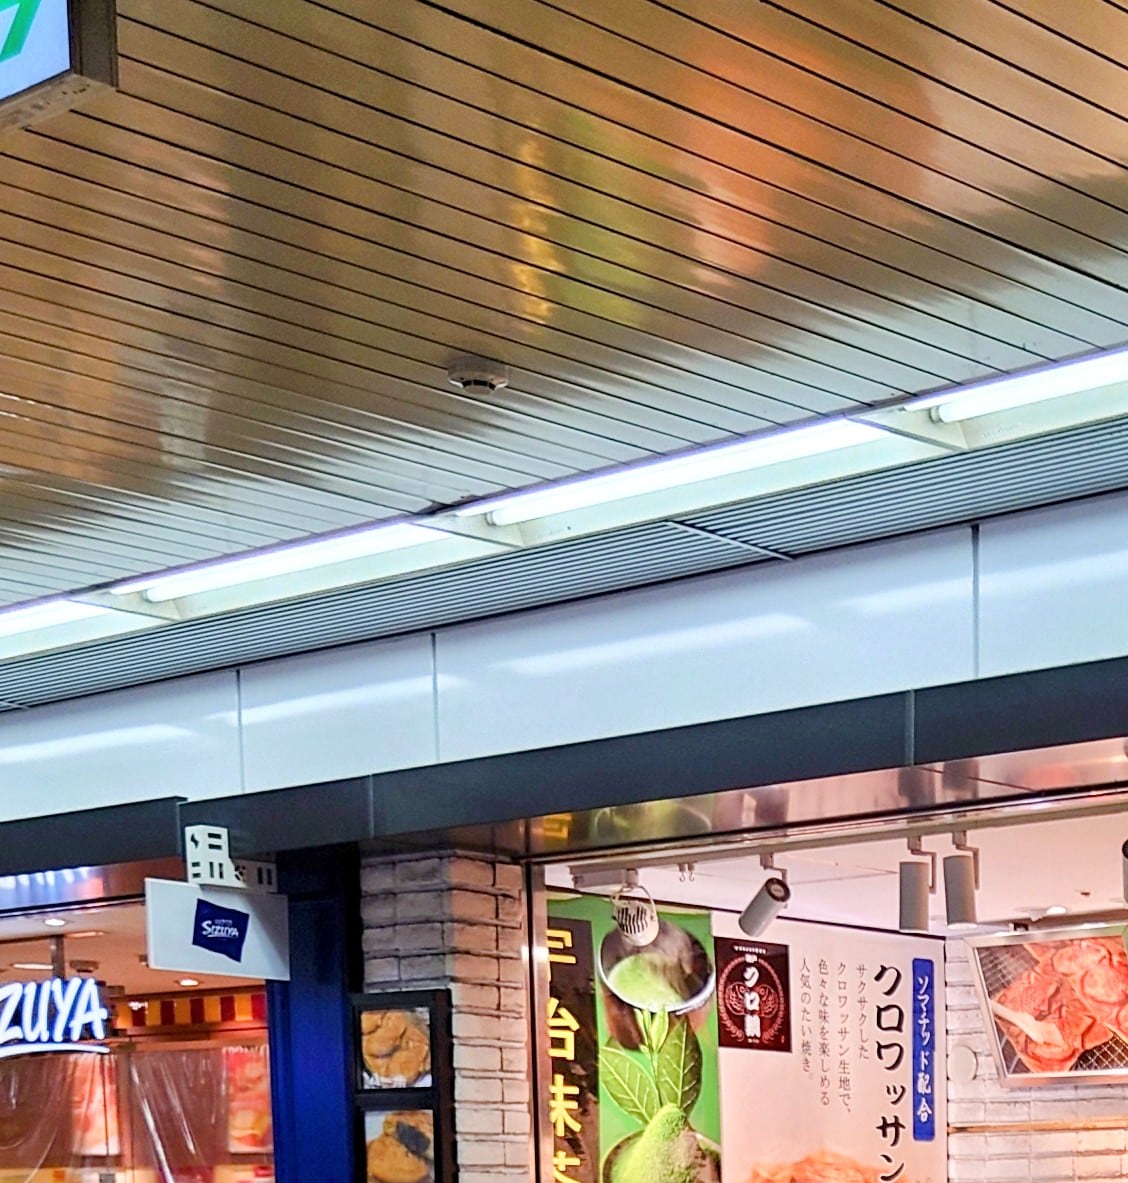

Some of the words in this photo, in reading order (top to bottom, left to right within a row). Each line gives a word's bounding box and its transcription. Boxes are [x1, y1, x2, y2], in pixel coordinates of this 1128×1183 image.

[0, 977, 108, 1043] ZUYA
[818, 959, 831, 1107] 色々な味を楽しめる
[856, 964, 870, 1060] サクサクした
